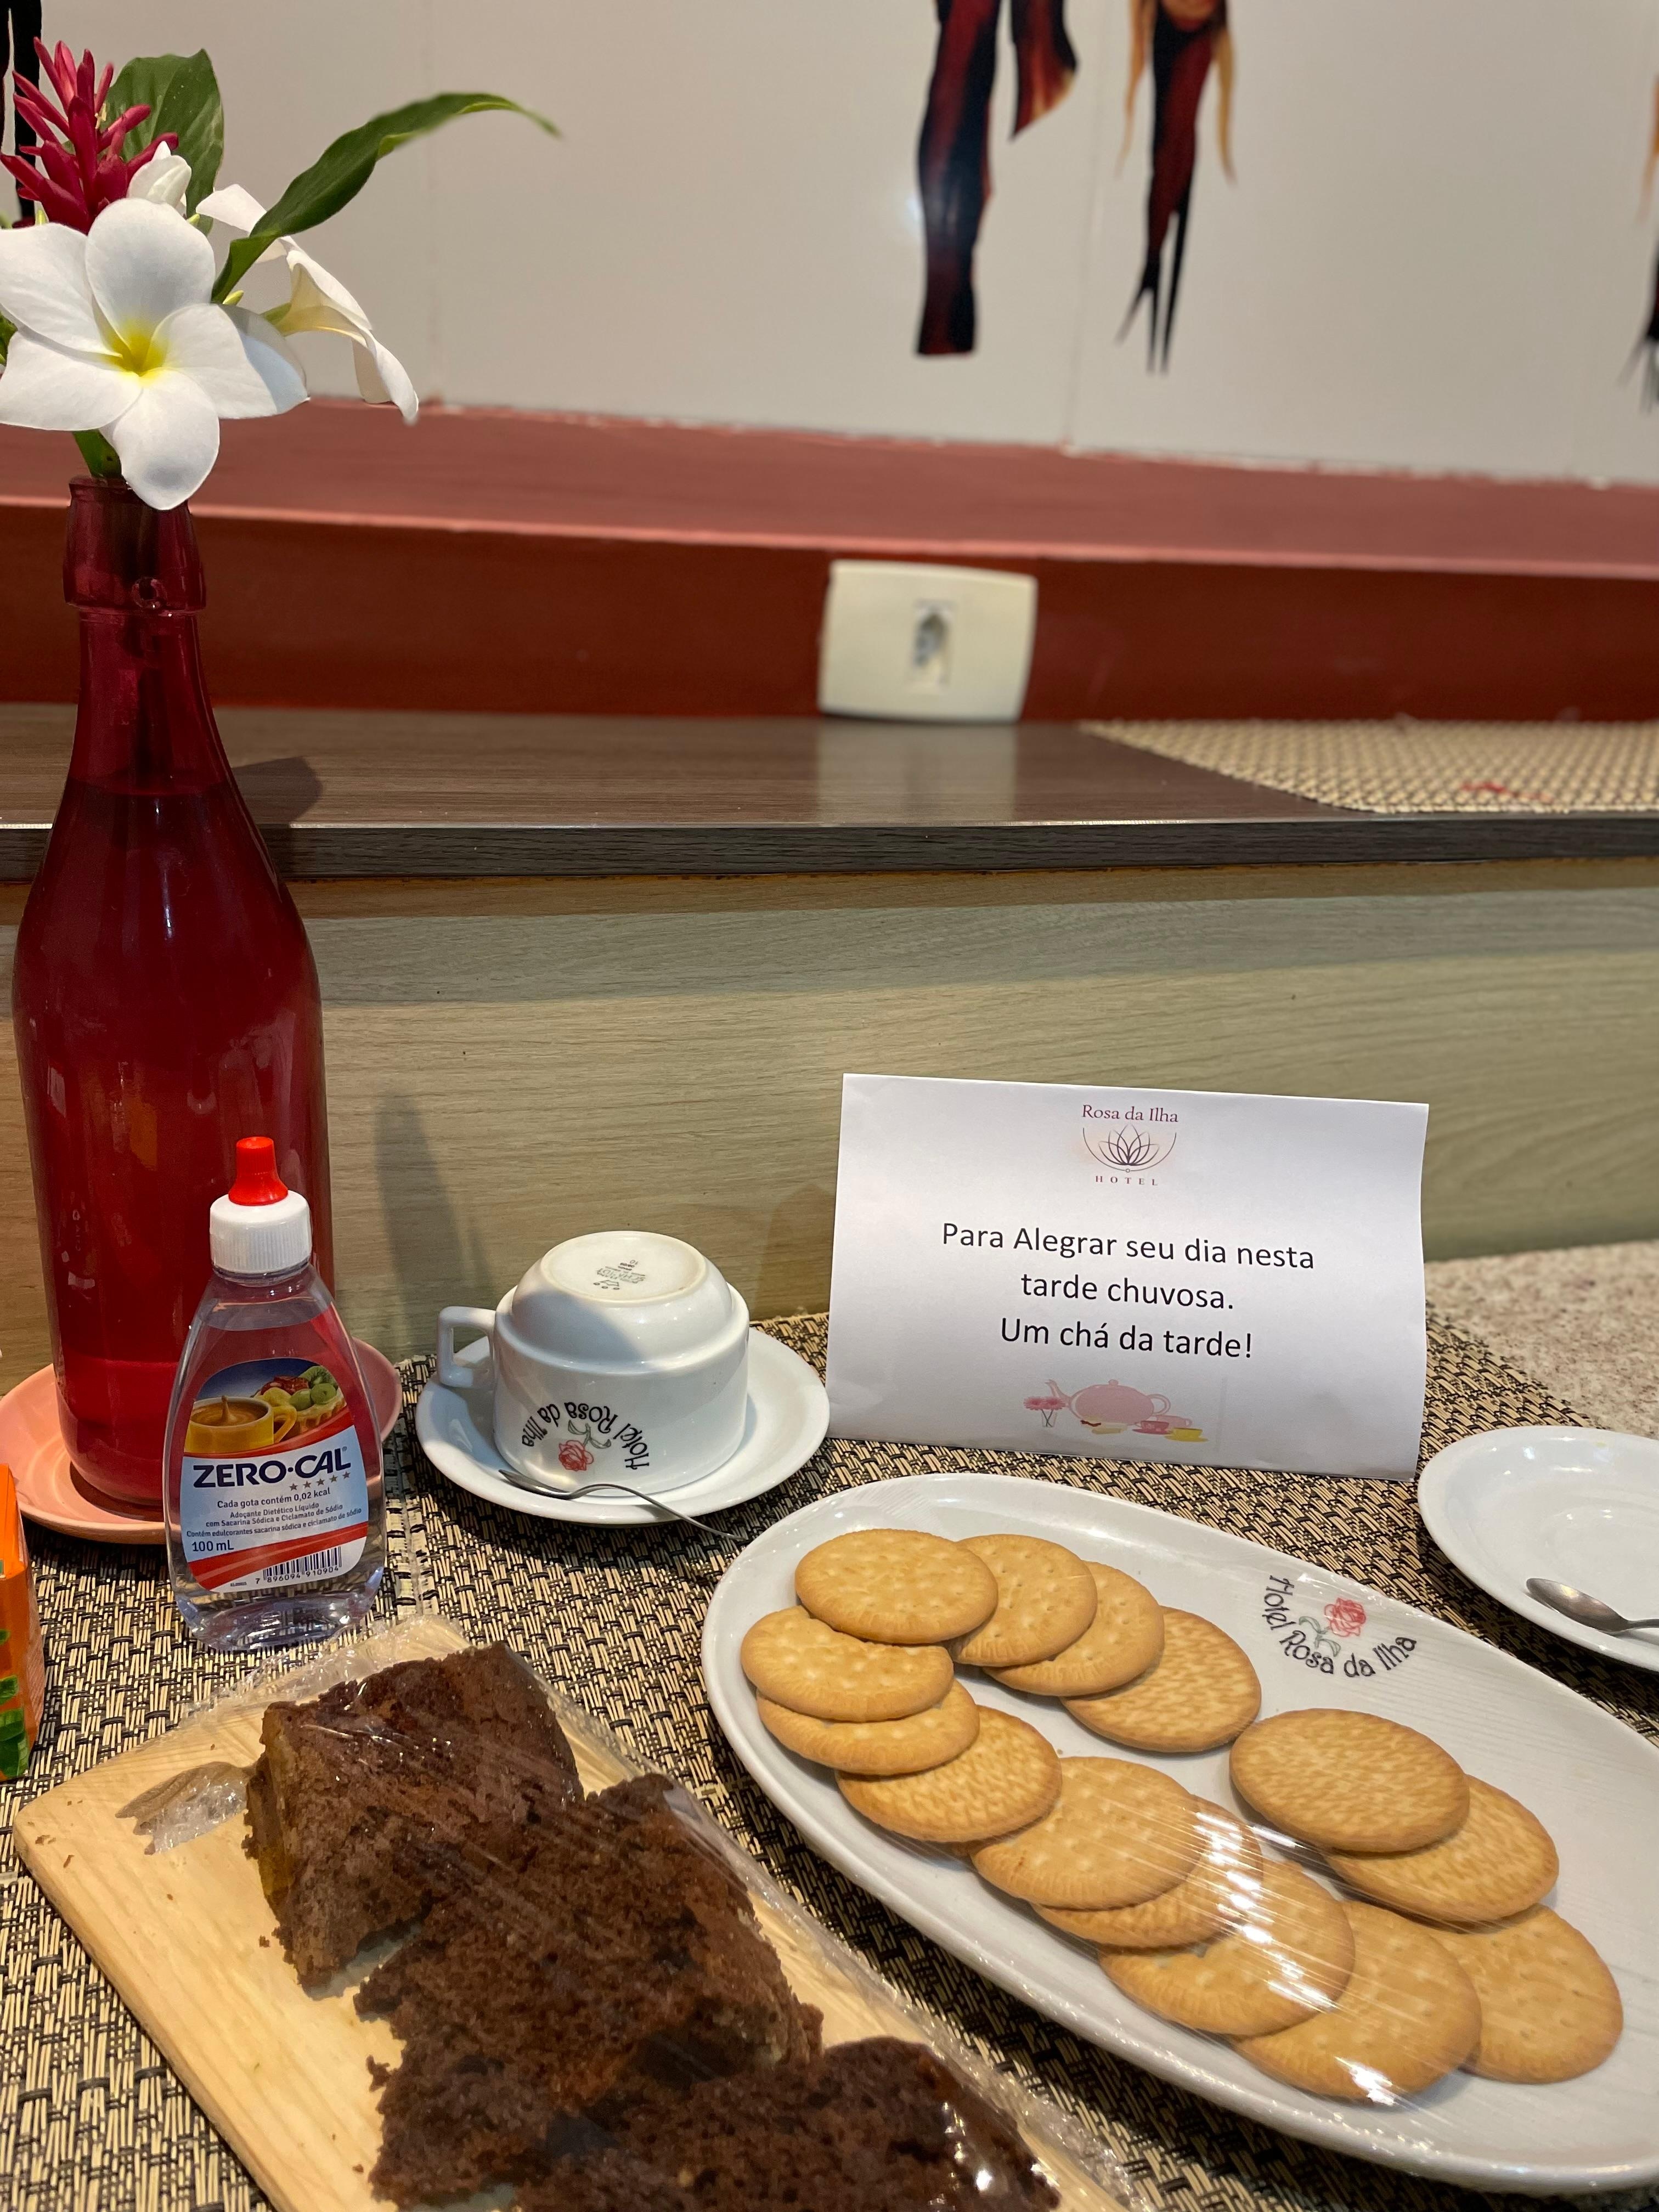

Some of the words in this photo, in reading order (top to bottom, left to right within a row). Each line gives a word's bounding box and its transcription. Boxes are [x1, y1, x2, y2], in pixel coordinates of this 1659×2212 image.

[1082, 1104, 1120, 1119] Rosa
[1125, 1106, 1144, 1121] da
[1149, 1108, 1178, 1122] Ilha
[1096, 1176, 1158, 1186] HOTEL
[943, 1222, 1003, 1248] Para
[1013, 1227, 1117, 1259] Alegrar
[1126, 1240, 1173, 1260] seu
[1184, 1238, 1226, 1263] dia
[1238, 1247, 1314, 1269] nesta
[1021, 1274, 1097, 1300] tarde
[1108, 1277, 1233, 1309] chuvosa.
[1001, 1317, 1049, 1344] Um
[1060, 1321, 1108, 1348] chá
[1119, 1325, 1153, 1351] da
[1163, 1330, 1251, 1358] tarde!
[537, 1404, 560, 1427] da
[564, 1402, 618, 1434] Rosa
[522, 1416, 548, 1447] Ilha
[612, 1423, 650, 1470] Hotel
[217, 1500, 239, 1508] Cada
[240, 1499, 259, 1509] gota
[261, 1495, 292, 1505] contém
[294, 1492, 312, 1502] 0,02
[314, 1487, 330, 1498] kcal
[230, 1510, 261, 1519] Adoçante
[263, 1506, 294, 1516] Dietético
[295, 1503, 319, 1512] Líquido
[212, 1528, 253, 1537] edulcorantes
[253, 1526, 280, 1534] sacarina
[281, 1523, 301, 1531] sódica
[308, 1515, 337, 1527] ciclamato
[347, 1508, 362, 1517] sódio
[221, 1519, 251, 1527] Sacarina
[252, 1516, 274, 1525] Sódica
[281, 1511, 314, 1521] Ciclamato
[325, 1504, 343, 1513] Sódio
[191, 1541, 213, 1551] 100
[216, 1539, 234, 1551] mL
[267, 1573, 301, 1583] 896094
[306, 1567, 339, 1577] 910904
[1262, 1575, 1296, 1630] Hotel
[1279, 1630, 1334, 1674] Rosa
[1344, 1652, 1376, 1678] da
[1372, 1637, 1417, 1671] Ilha
